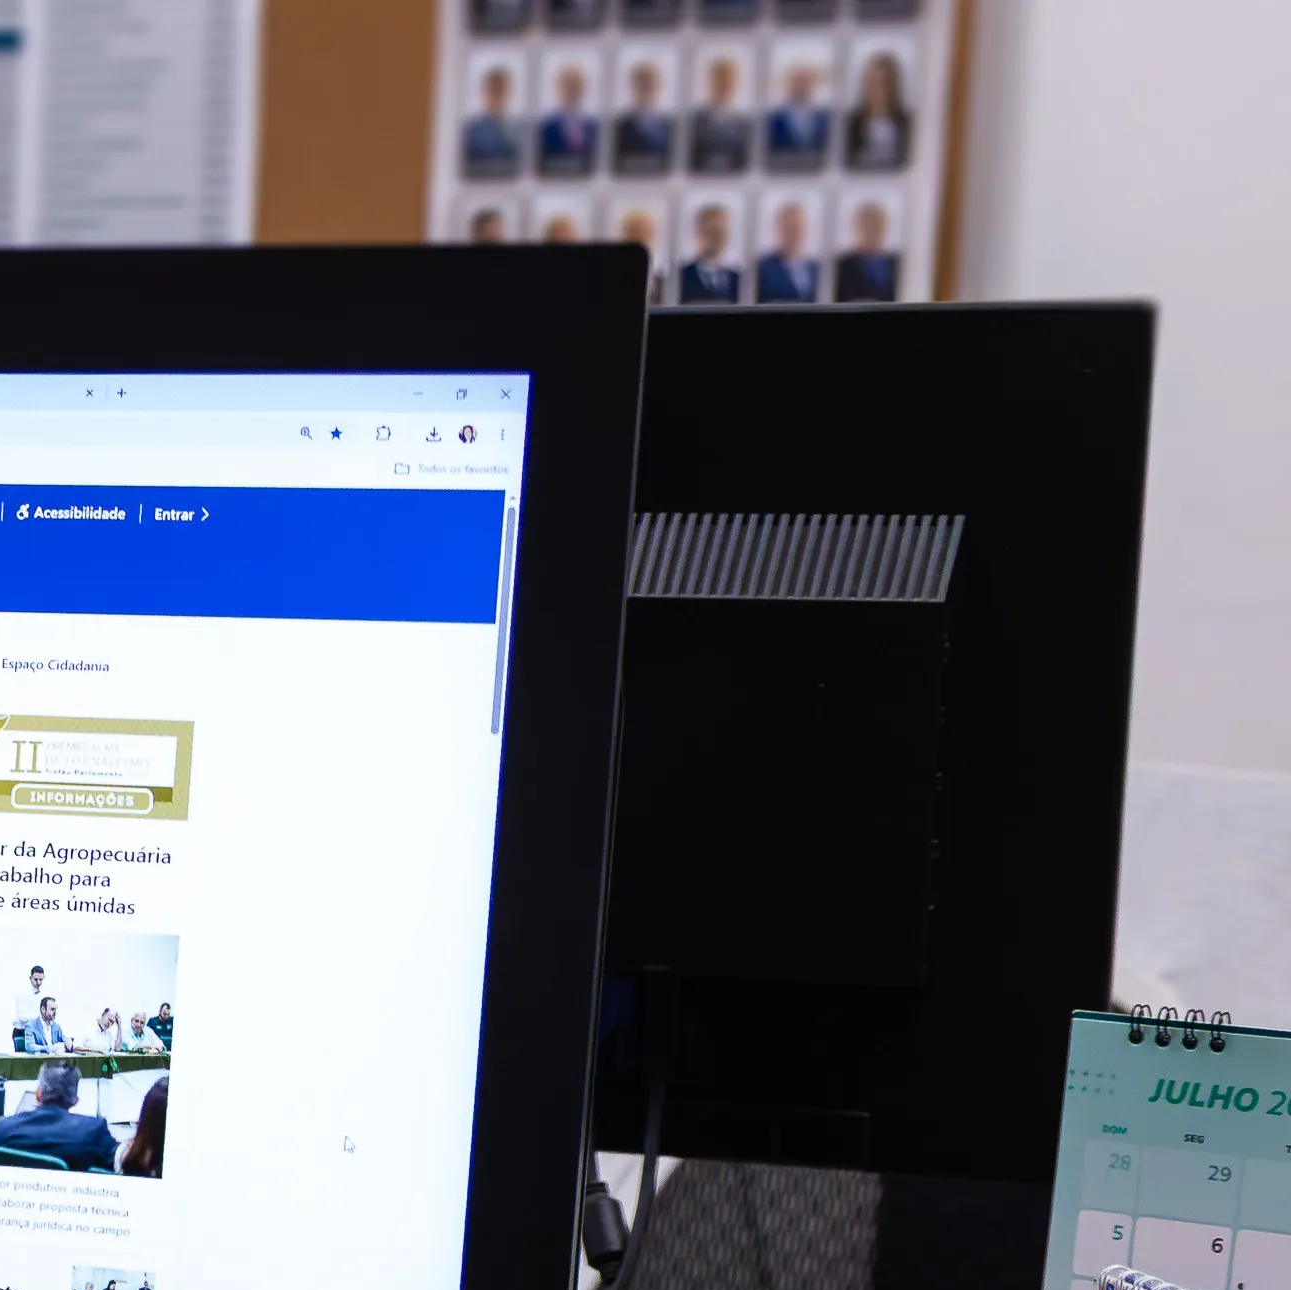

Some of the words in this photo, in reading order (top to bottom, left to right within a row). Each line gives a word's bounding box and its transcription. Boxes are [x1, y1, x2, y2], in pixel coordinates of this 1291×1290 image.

[33, 505, 126, 520] Acessibilidade
[154, 508, 195, 521] Entrar
[2, 657, 44, 673] Espaço
[47, 658, 110, 673] Cidadania
[29, 789, 135, 808] INFORMAÇÕES
[14, 841, 37, 858] da
[42, 843, 172, 867] Agropecuária
[69, 873, 111, 890] para
[11, 892, 60, 911] áreas
[67, 895, 135, 915] úmidas
[1147, 1078, 1260, 1113] JULHO
[1102, 1124, 1128, 1136] DOM
[1184, 1133, 1205, 1145] SEG
[1108, 1152, 1131, 1171] 28
[1207, 1164, 1232, 1183] 29
[1111, 1225, 1124, 1241] 5
[1212, 1237, 1224, 1254] 6
